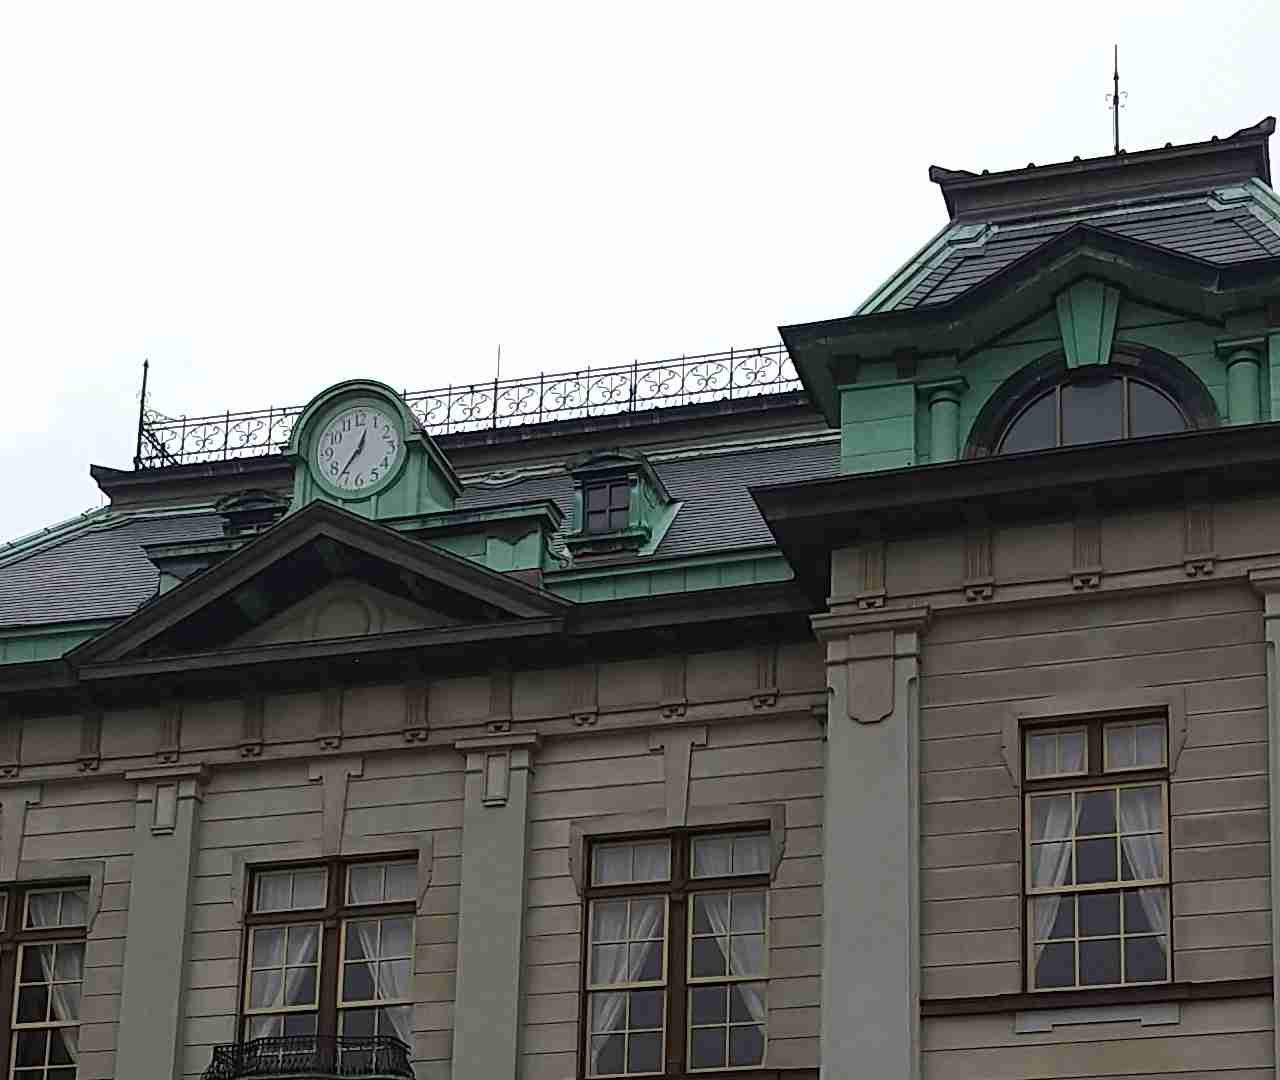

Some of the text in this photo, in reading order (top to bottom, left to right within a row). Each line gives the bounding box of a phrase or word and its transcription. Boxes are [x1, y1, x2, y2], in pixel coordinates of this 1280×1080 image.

[342, 418, 351, 432] 11
[355, 413, 366, 427] 12
[327, 432, 342, 445] 10
[382, 425, 390, 439] 2
[324, 447, 334, 461] 9
[386, 441, 396, 455] 3
[330, 461, 339, 476] 8
[380, 456, 388, 469] 4
[342, 471, 350, 486] 7
[355, 473, 364, 487] 6
[370, 467, 379, 482] 5
